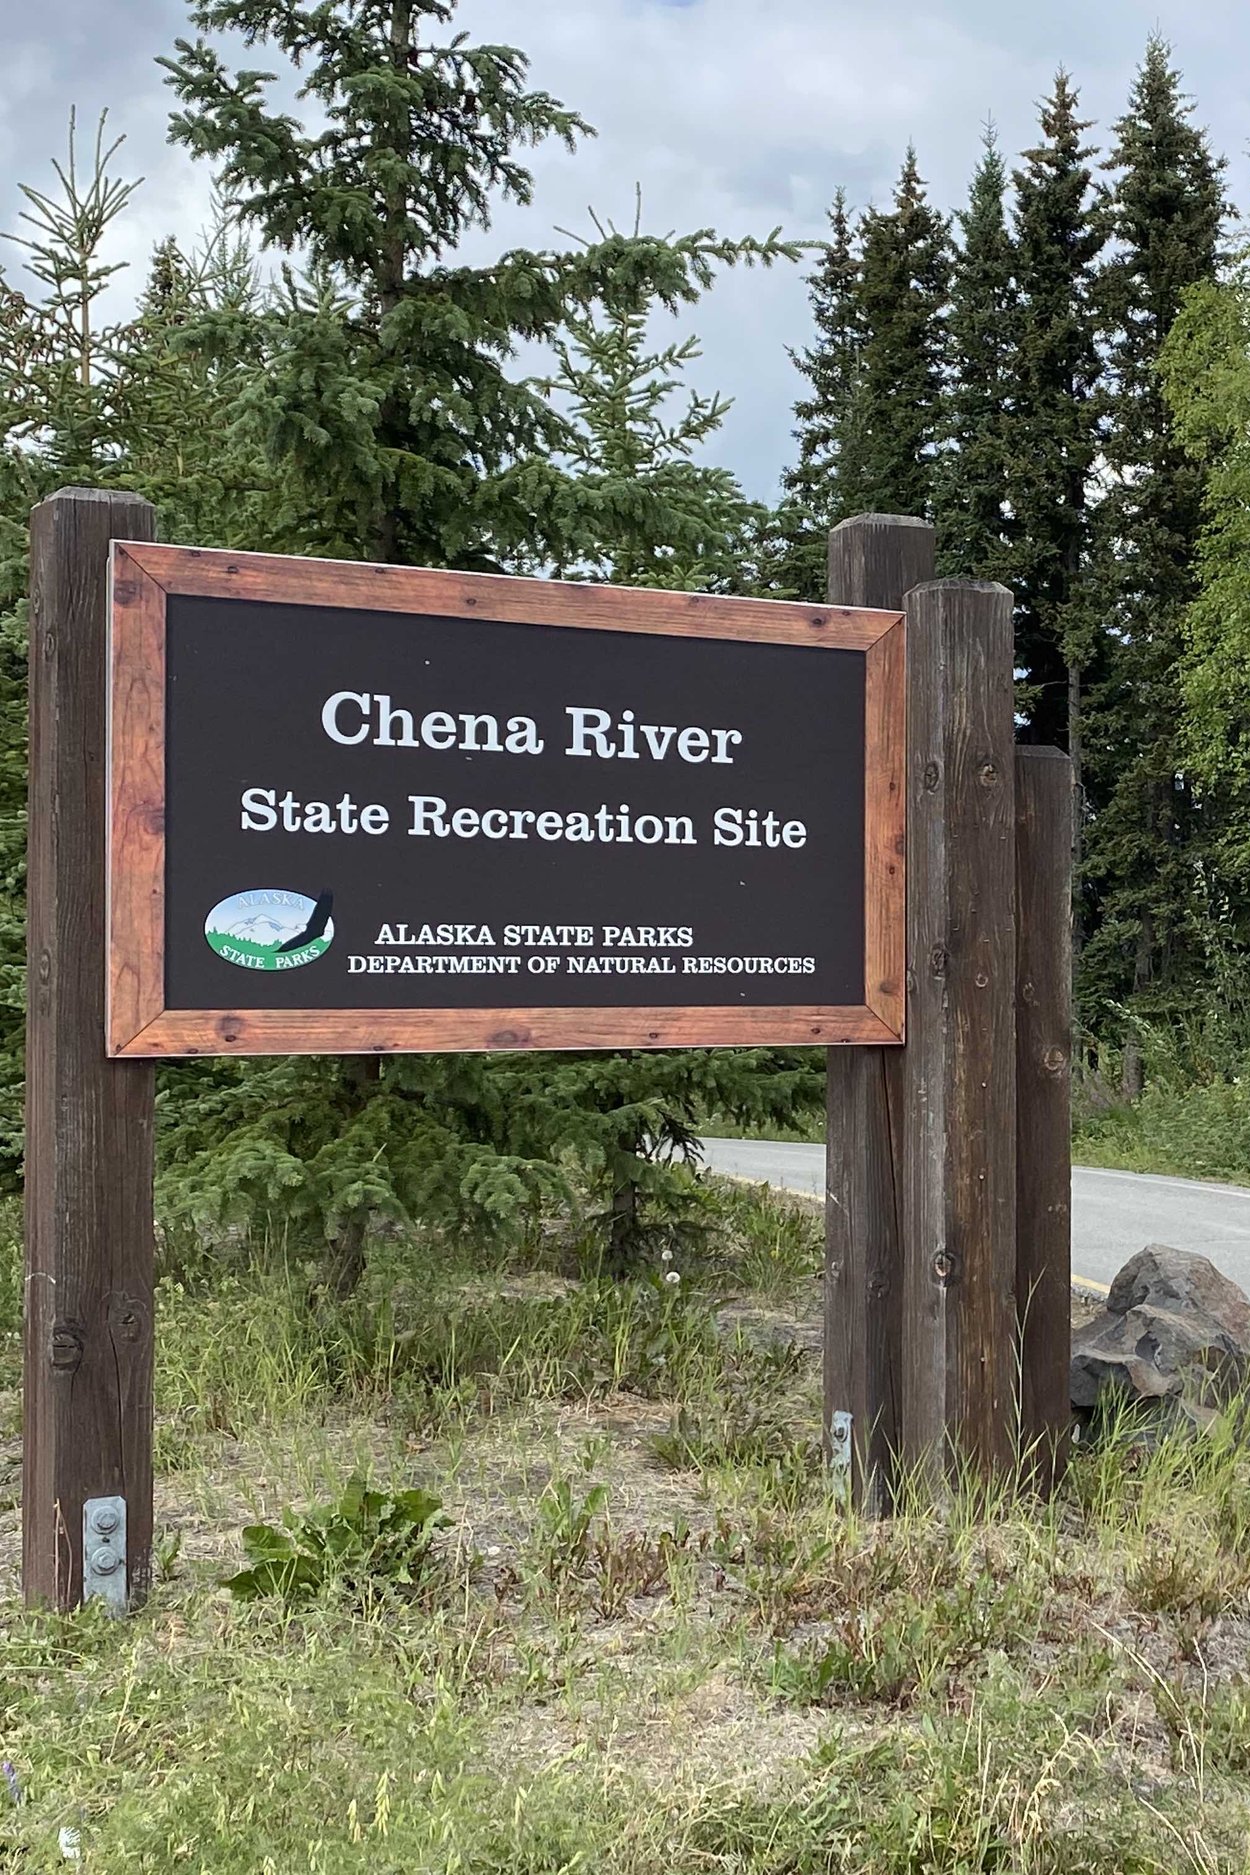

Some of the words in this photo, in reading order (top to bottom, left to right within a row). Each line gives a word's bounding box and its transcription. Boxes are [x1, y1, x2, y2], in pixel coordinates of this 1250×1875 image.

[321, 691, 545, 755] Chena
[565, 706, 743, 764] River
[241, 787, 390, 835] State
[407, 795, 698, 845] Recreation
[713, 807, 807, 849] Site
[237, 891, 305, 910] ALASKA
[374, 923, 497, 946] ALASKA
[503, 924, 594, 947] STATE
[601, 926, 694, 948] PARKS
[219, 944, 265, 969] STATE
[275, 944, 321, 969] PARKS
[347, 955, 522, 974] DEPARTMENT
[527, 955, 561, 974] OF
[566, 956, 677, 974] NATURAL
[681, 956, 816, 974] RESOURCES
